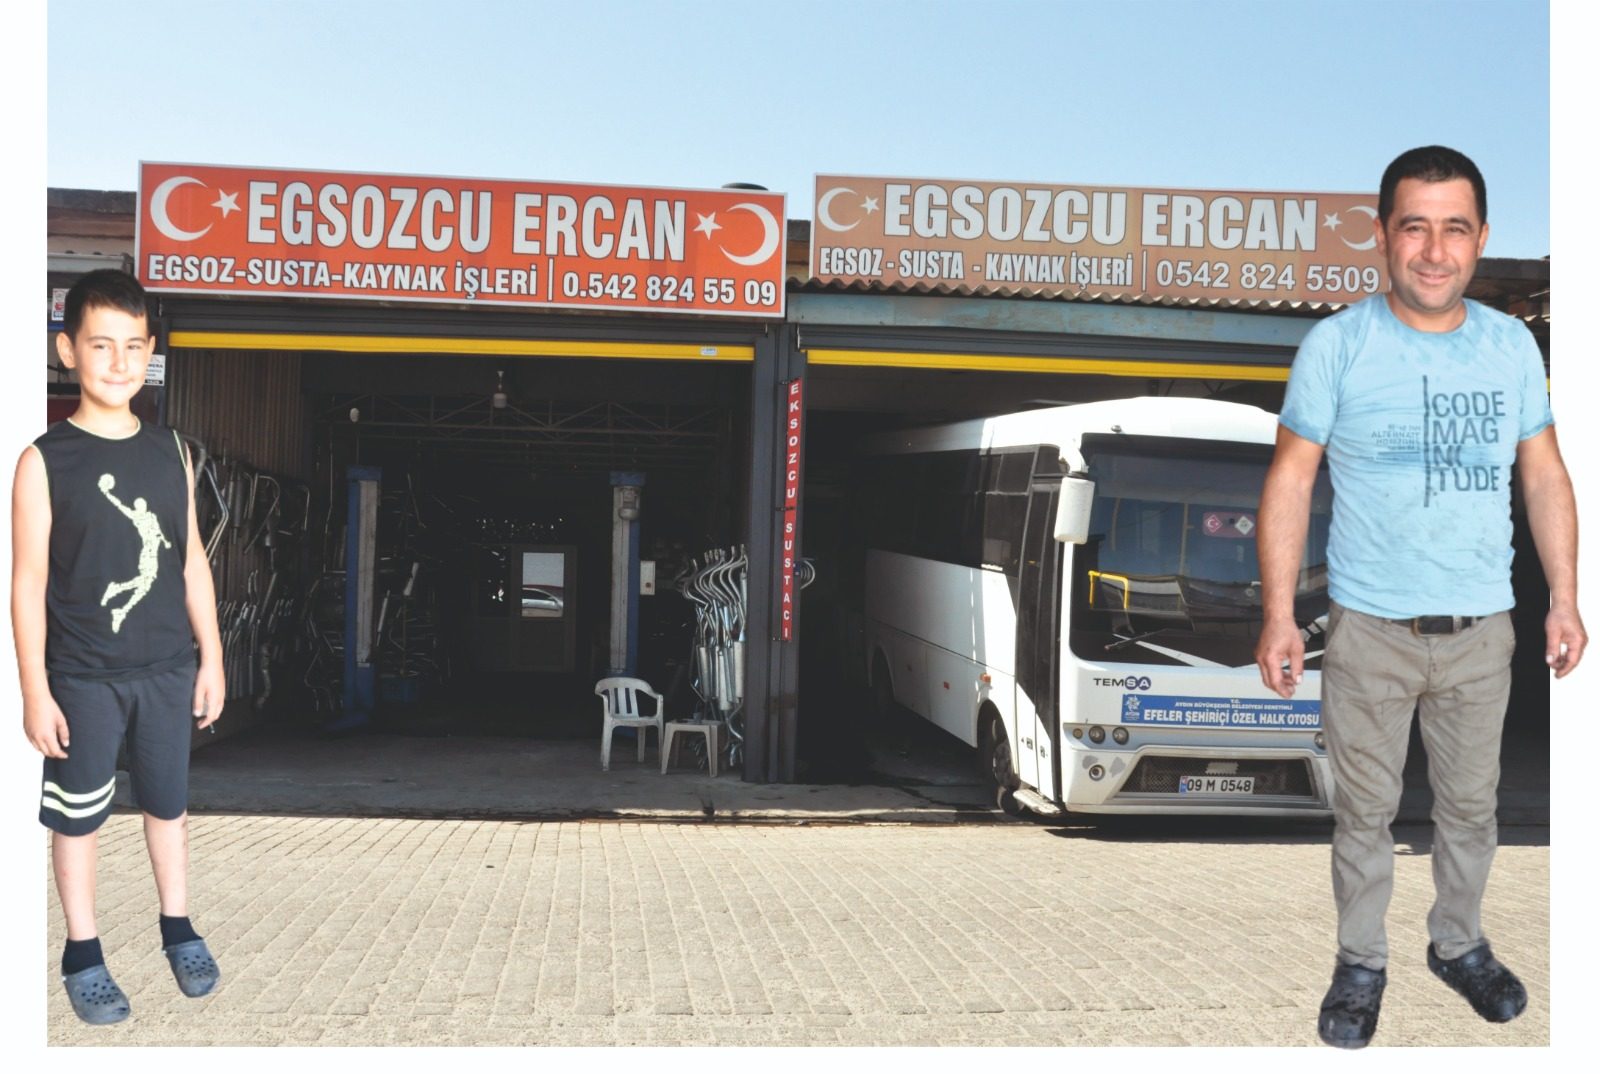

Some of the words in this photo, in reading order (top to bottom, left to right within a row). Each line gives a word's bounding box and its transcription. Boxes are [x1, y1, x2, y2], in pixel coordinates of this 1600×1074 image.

[247, 180, 492, 254] EGSOZCU
[512, 191, 686, 262] ERCAN
[884, 183, 1127, 245] EGSOZCU
[1141, 193, 1318, 251] ERCAN
[454, 261, 537, 300] İŞLERİ
[819, 247, 883, 277] EGSOZ
[899, 249, 964, 280] SUSTA
[985, 251, 1066, 283] KAYNAK
[1069, 252, 1133, 290] İŞLERİ
[1156, 260, 1230, 289] 0542
[1240, 262, 1296, 291] 824
[1306, 265, 1380, 293] 5509
[563, 271, 637, 300] 0.542
[646, 275, 695, 302] 824
[703, 278, 735, 304] 55
[744, 280, 776, 306] 09
[1432, 391, 1506, 418] CODE
[786, 383, 799, 498] EKSOZCU
[1433, 417, 1499, 445] MAG
[1433, 466, 1500, 491] TUDE
[783, 522, 793, 638] SUSTACI
[1093, 676, 1151, 691] TEMSA
[1143, 709, 1183, 722] EFELER
[1185, 709, 1229, 726] ŞEHİRİÇİ
[1231, 709, 1257, 724] ÖZEL
[1259, 713, 1286, 725] HALK
[1287, 713, 1320, 725] OTOSU
[1186, 779, 1202, 791] 09
[1206, 779, 1216, 792] M
[1220, 779, 1252, 792] 0548
